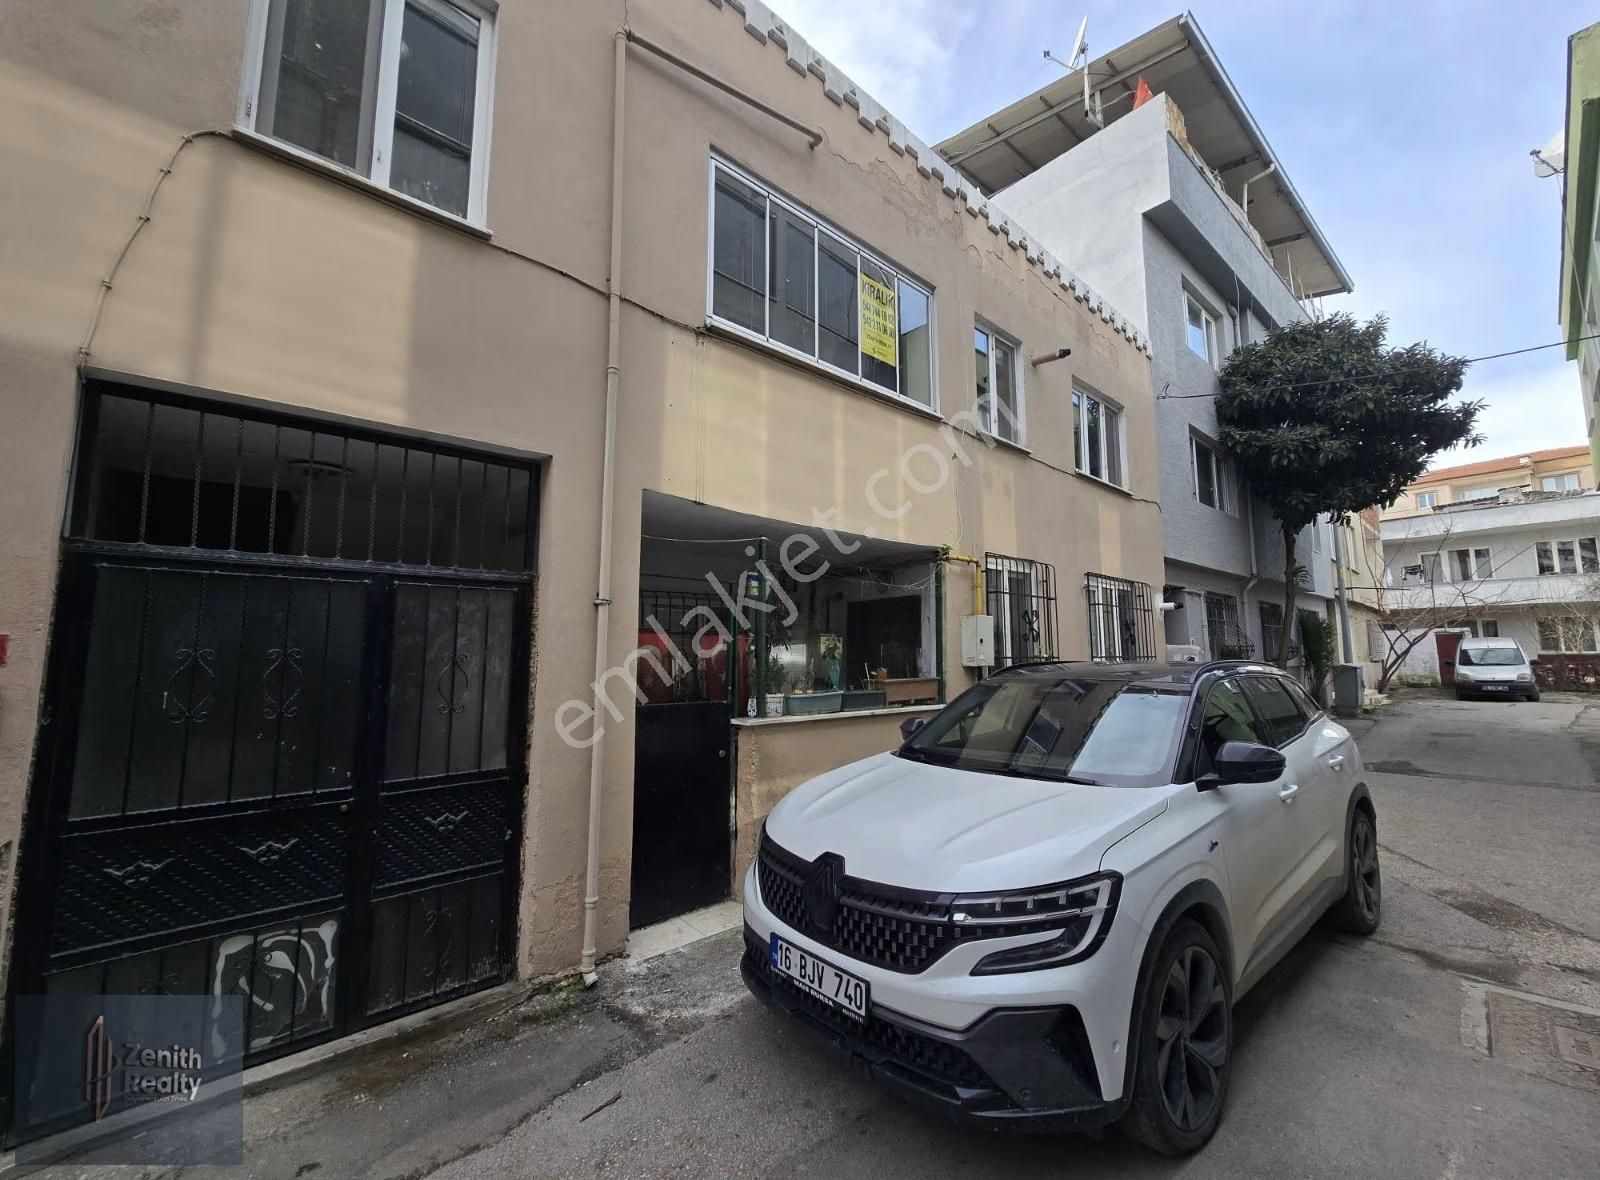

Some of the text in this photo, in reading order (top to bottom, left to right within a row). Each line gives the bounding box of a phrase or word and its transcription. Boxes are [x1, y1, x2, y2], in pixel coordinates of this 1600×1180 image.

[779, 943, 791, 971] 16
[800, 954, 824, 989] BJV
[834, 971, 862, 1011] 740
[810, 989, 833, 1007] BURSA
